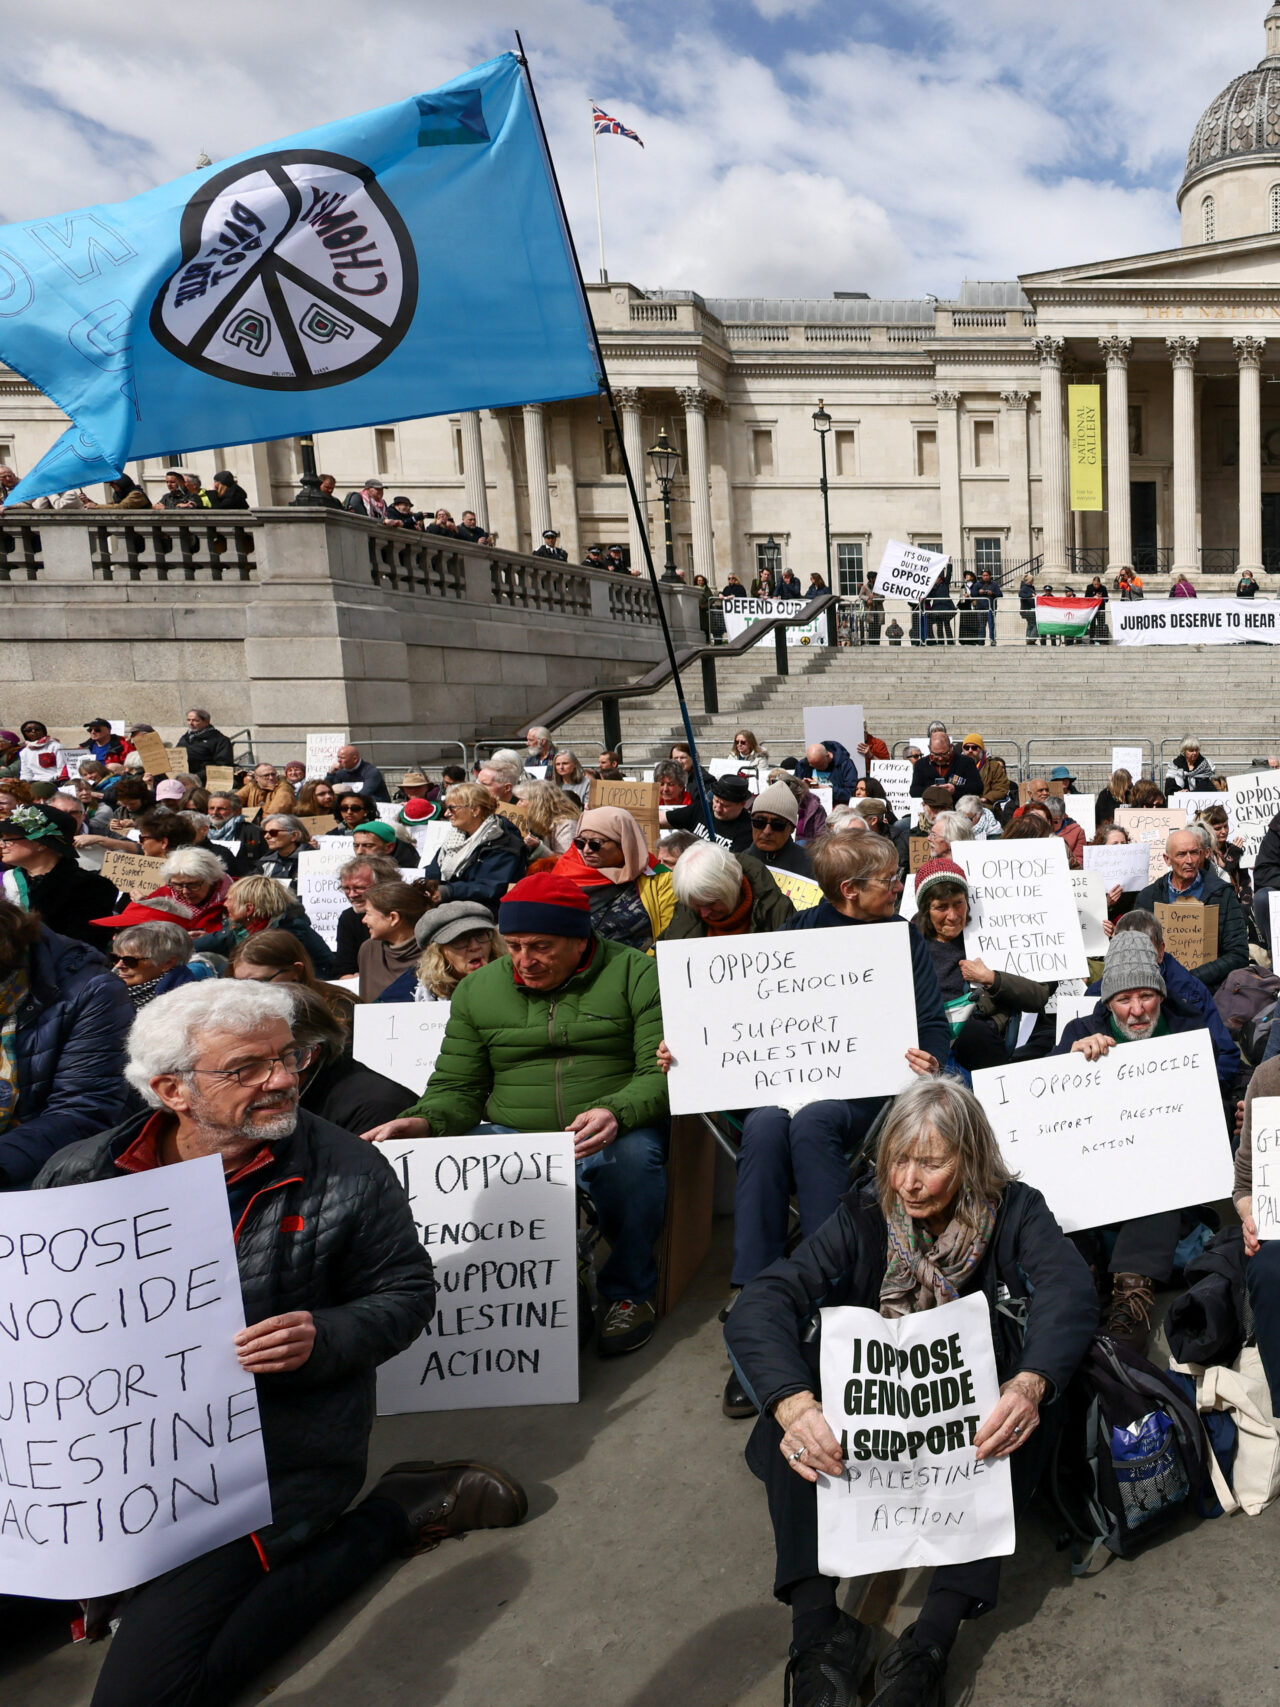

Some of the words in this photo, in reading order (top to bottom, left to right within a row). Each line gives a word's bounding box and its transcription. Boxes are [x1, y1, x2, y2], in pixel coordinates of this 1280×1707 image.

[1144, 307, 1184, 319] THE
[1077, 405, 1086, 465] NATIONAL
[1086, 406, 1096, 465] GALLERY
[917, 553, 931, 563] OUR
[892, 568, 931, 587] OPPOSE
[724, 600, 773, 614] DEFEND
[1120, 614, 1166, 631] JURORS
[1170, 613, 1222, 628] DESERVE
[1226, 613, 1241, 628] TO
[1244, 613, 1275, 628] HEAR
[1256, 776, 1260, 787] I
[608, 789, 647, 807] OPPOSE
[1129, 815, 1171, 829] OPPOSE
[113, 853, 135, 866] OPPOSE
[966, 860, 971, 876] I
[982, 858, 1057, 880] OPPOSE
[121, 867, 145, 879] SUPPORT
[979, 915, 983, 929] I
[989, 911, 1048, 928] SUPPORT
[978, 931, 1066, 953] PALESTINE
[686, 956, 693, 988] I
[709, 951, 798, 985] OPPOSE
[1004, 951, 1068, 977] ACTION
[757, 968, 875, 1000] GENOCIDE
[386, 1014, 399, 1040] I
[703, 1026, 708, 1046] I
[733, 1015, 839, 1042] SUPPORT
[721, 1037, 859, 1068] PALESTINE
[755, 1066, 842, 1090] ACTION
[994, 1076, 1009, 1105] I
[1029, 1070, 1102, 1098] OPPOSE
[1117, 1053, 1200, 1081] GENOCIDE
[1008, 1129, 1019, 1143] I
[1037, 1115, 1093, 1137] SUPPORT
[1120, 1103, 1185, 1121] PALESTINE
[1081, 1135, 1135, 1155] ACTION
[394, 1150, 418, 1202] I
[435, 1152, 568, 1195] OPPOSE
[1257, 1164, 1270, 1188] I
[423, 1299, 569, 1337] LESTINE
[419, 1349, 540, 1386] ACTION
[852, 1338, 862, 1374] I
[867, 1332, 965, 1380] OPPOSE
[843, 1369, 976, 1420] GENOCIDE
[840, 1429, 850, 1460] I
[853, 1415, 981, 1462] SUPPORT
[846, 1460, 985, 1493] PALESTINE
[1, 1463, 220, 1545] ACTION
[871, 1503, 965, 1532] ACTION
